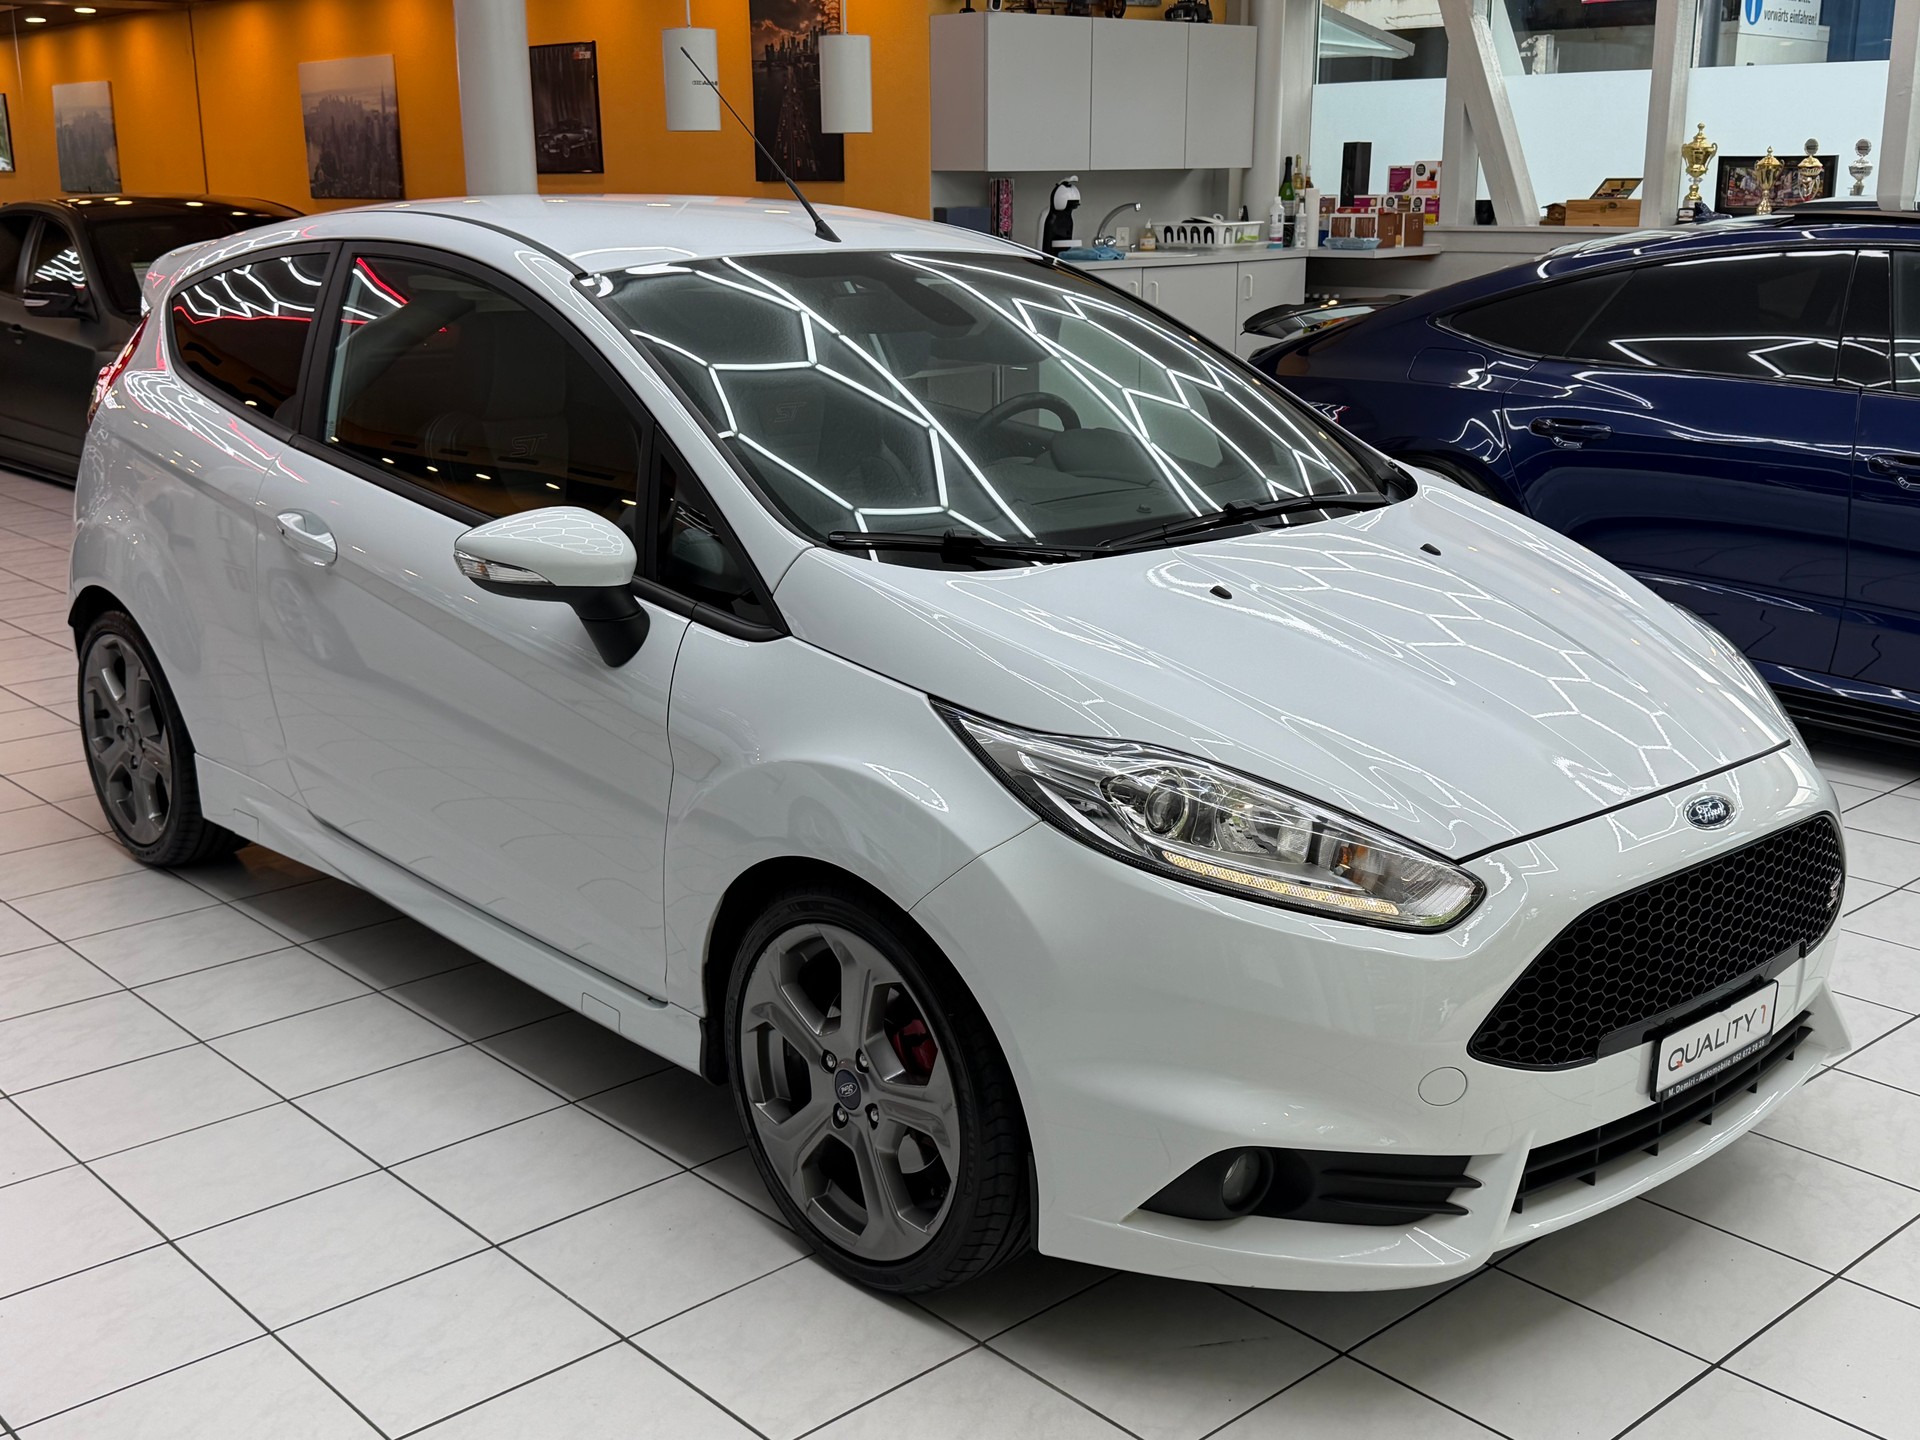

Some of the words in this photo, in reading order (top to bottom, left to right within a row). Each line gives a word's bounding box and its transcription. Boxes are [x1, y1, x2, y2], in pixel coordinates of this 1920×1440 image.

[1764, 8, 1789, 23] vorwärts
[1790, 9, 1818, 26] einfahren!
[510, 433, 547, 458] ST
[1668, 1008, 1757, 1071] QUALITY
[1760, 1004, 1767, 1024] 1
